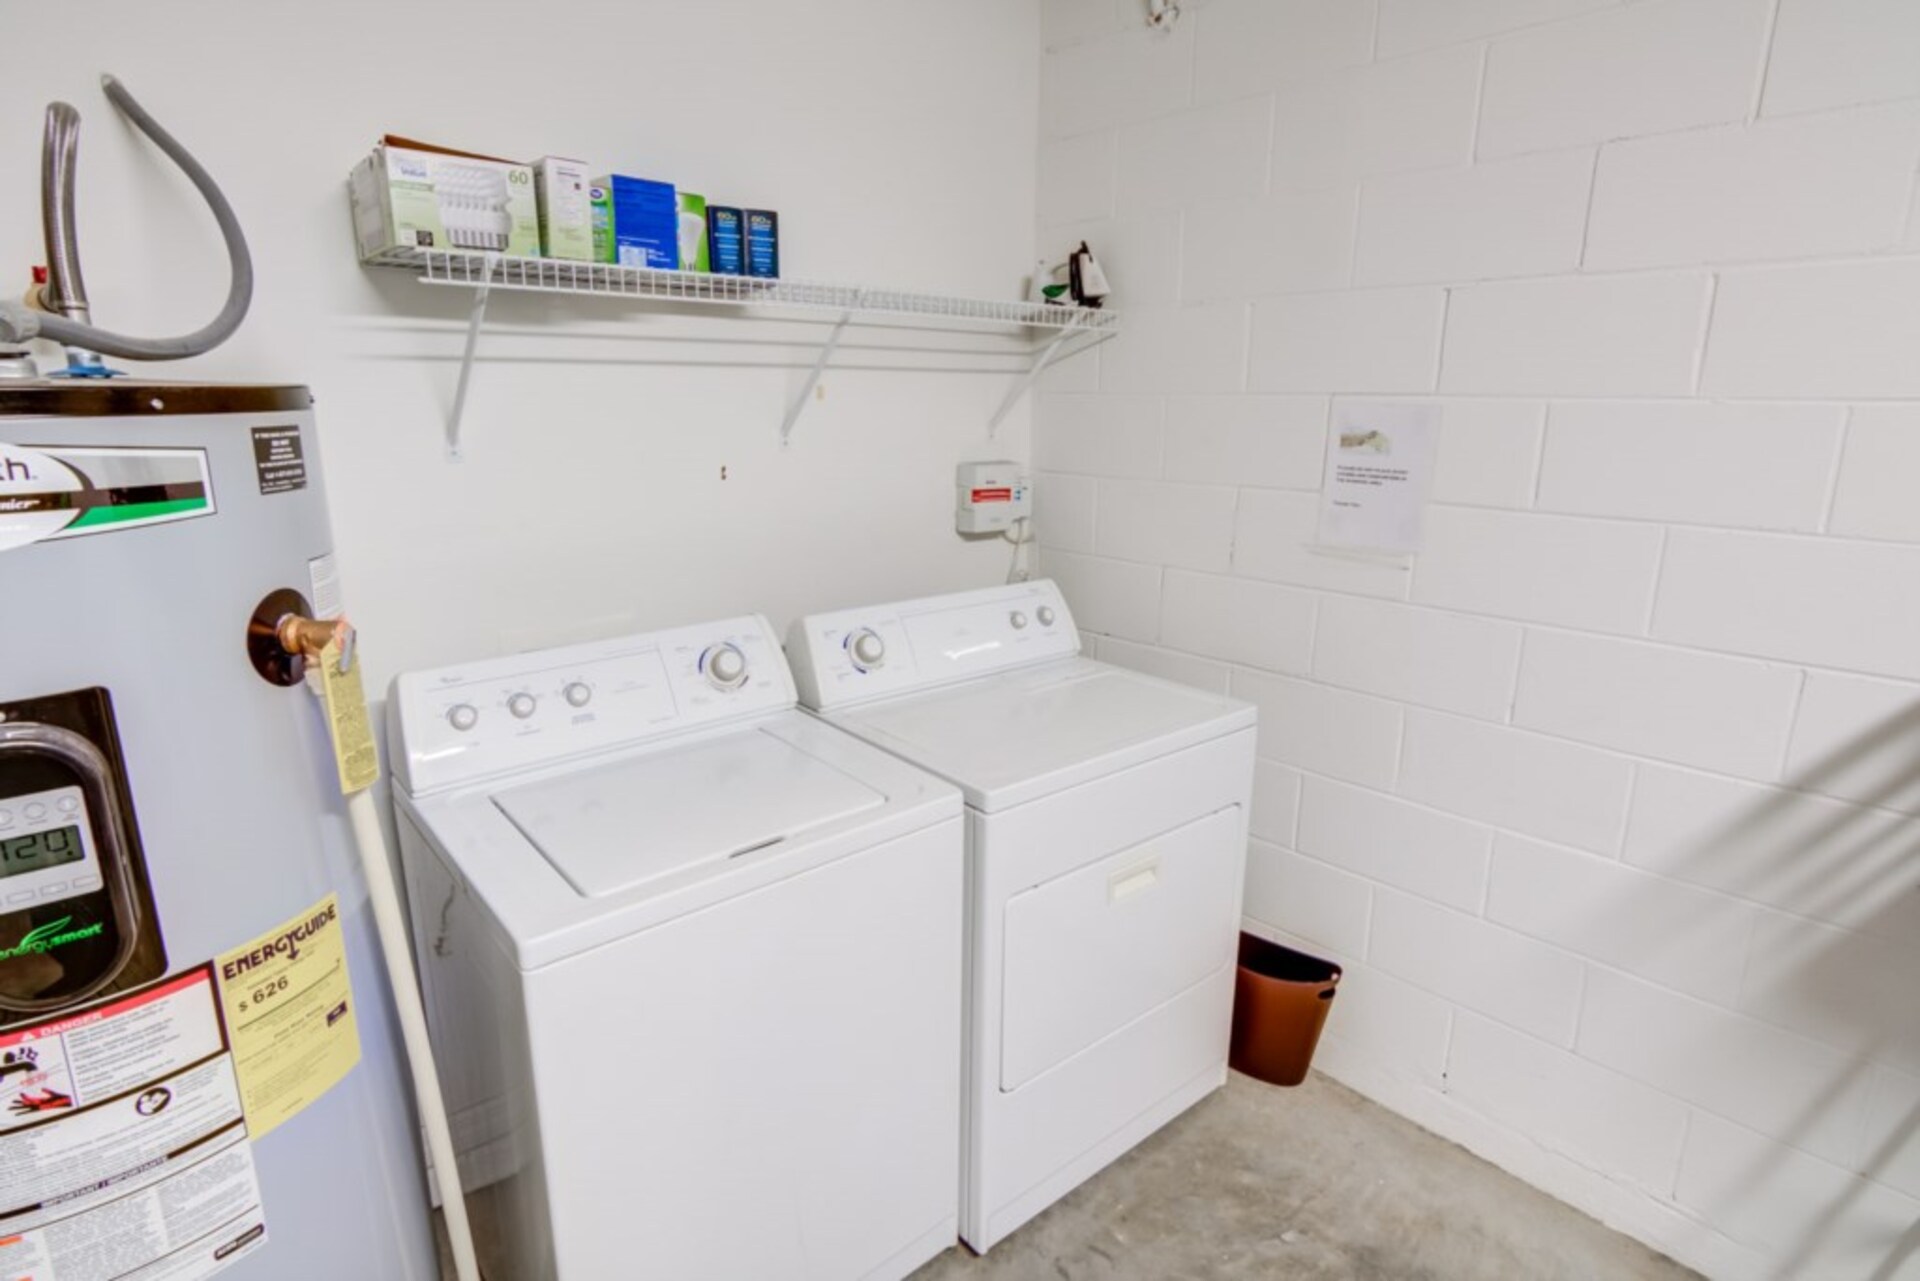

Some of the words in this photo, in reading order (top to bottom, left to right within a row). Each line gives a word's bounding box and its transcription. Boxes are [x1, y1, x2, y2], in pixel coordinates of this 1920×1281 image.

[509, 170, 528, 184] 60
[222, 903, 336, 981] ENERGYGUIDE
[252, 974, 289, 1005] 626
